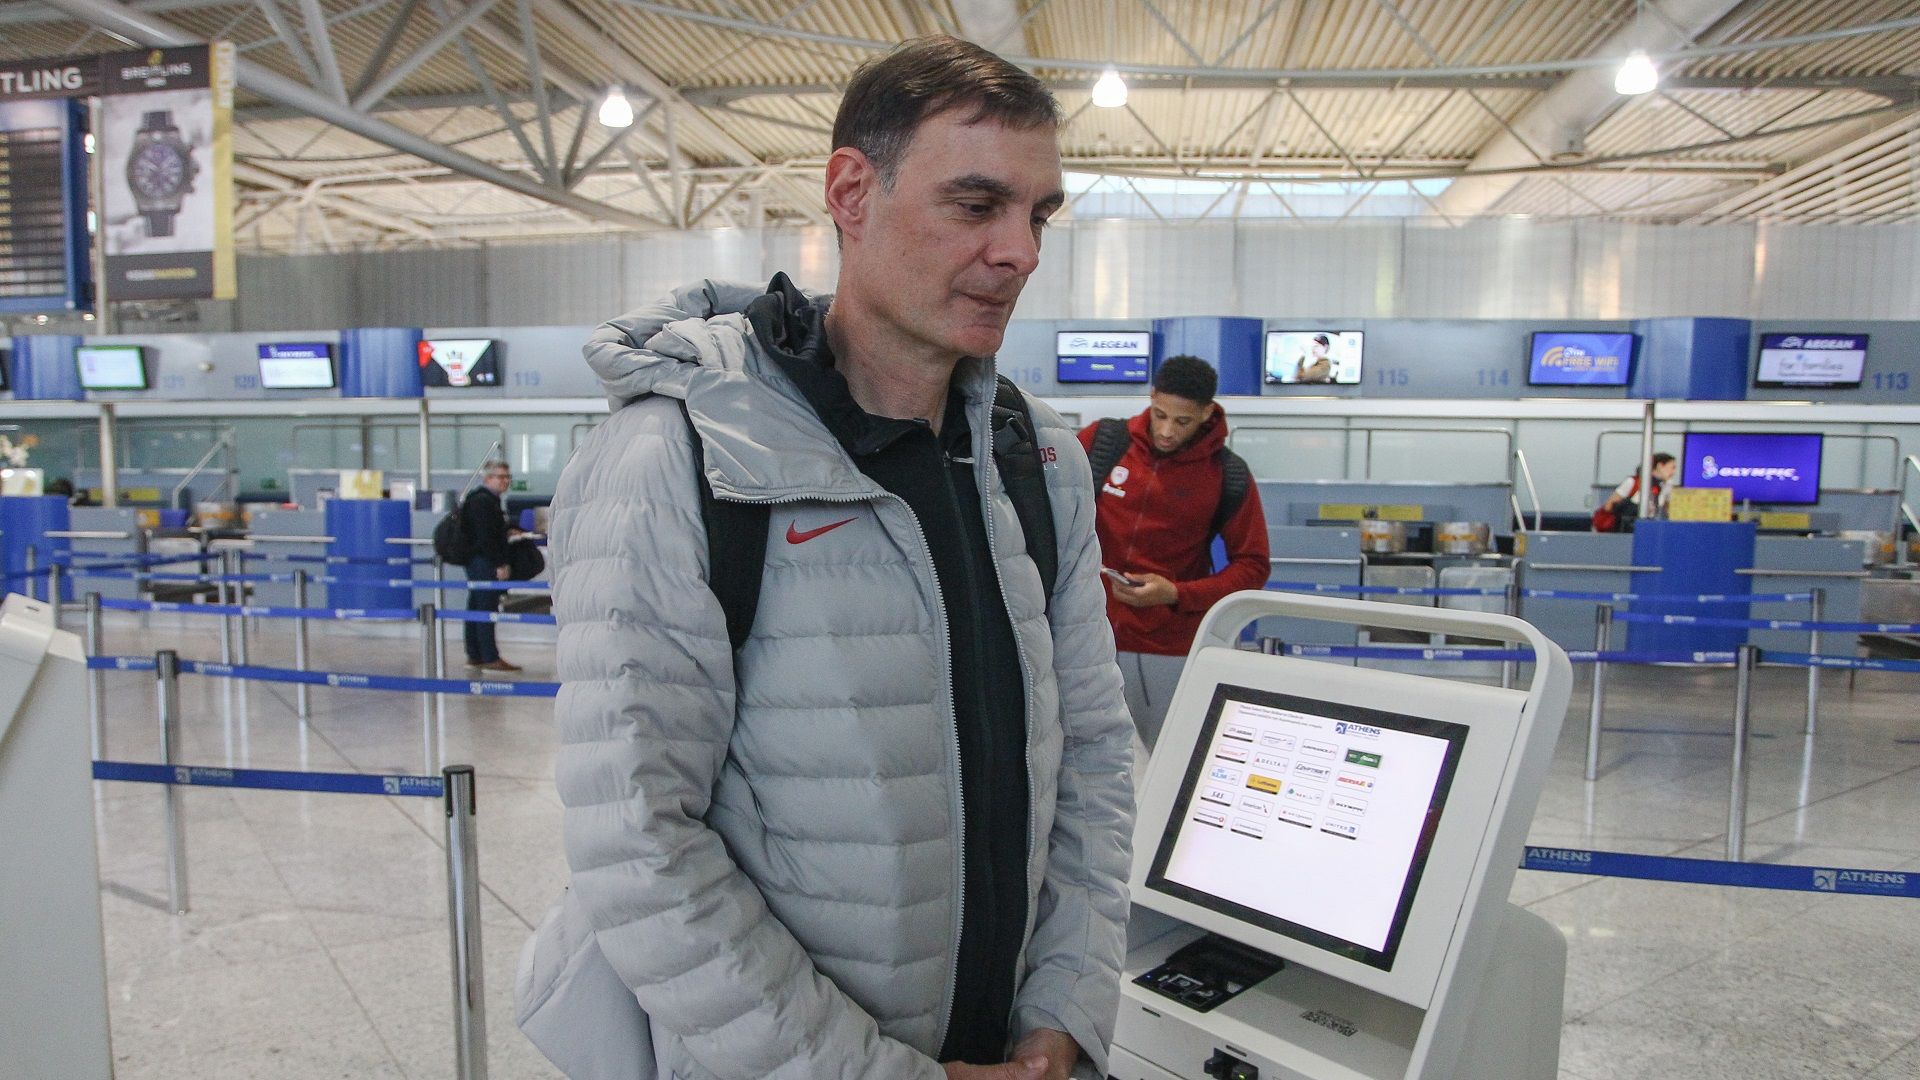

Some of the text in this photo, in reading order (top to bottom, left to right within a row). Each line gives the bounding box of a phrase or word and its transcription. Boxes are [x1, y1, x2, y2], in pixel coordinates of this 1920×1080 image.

[0, 66, 83, 94] TLING
[1092, 341, 1138, 349] AEGEAN
[515, 371, 541, 386] 119
[1013, 367, 1042, 384] 116
[1377, 367, 1409, 385] 115
[1478, 368, 1509, 386] 114
[1872, 371, 1909, 390] 113
[1718, 467, 1797, 478] OLYMPIC
[1348, 724, 1381, 735] ATHENS
[1261, 759, 1281, 767] DELTA
[1528, 848, 1591, 863] ATHENS
[1837, 871, 1906, 885] ATHENS
